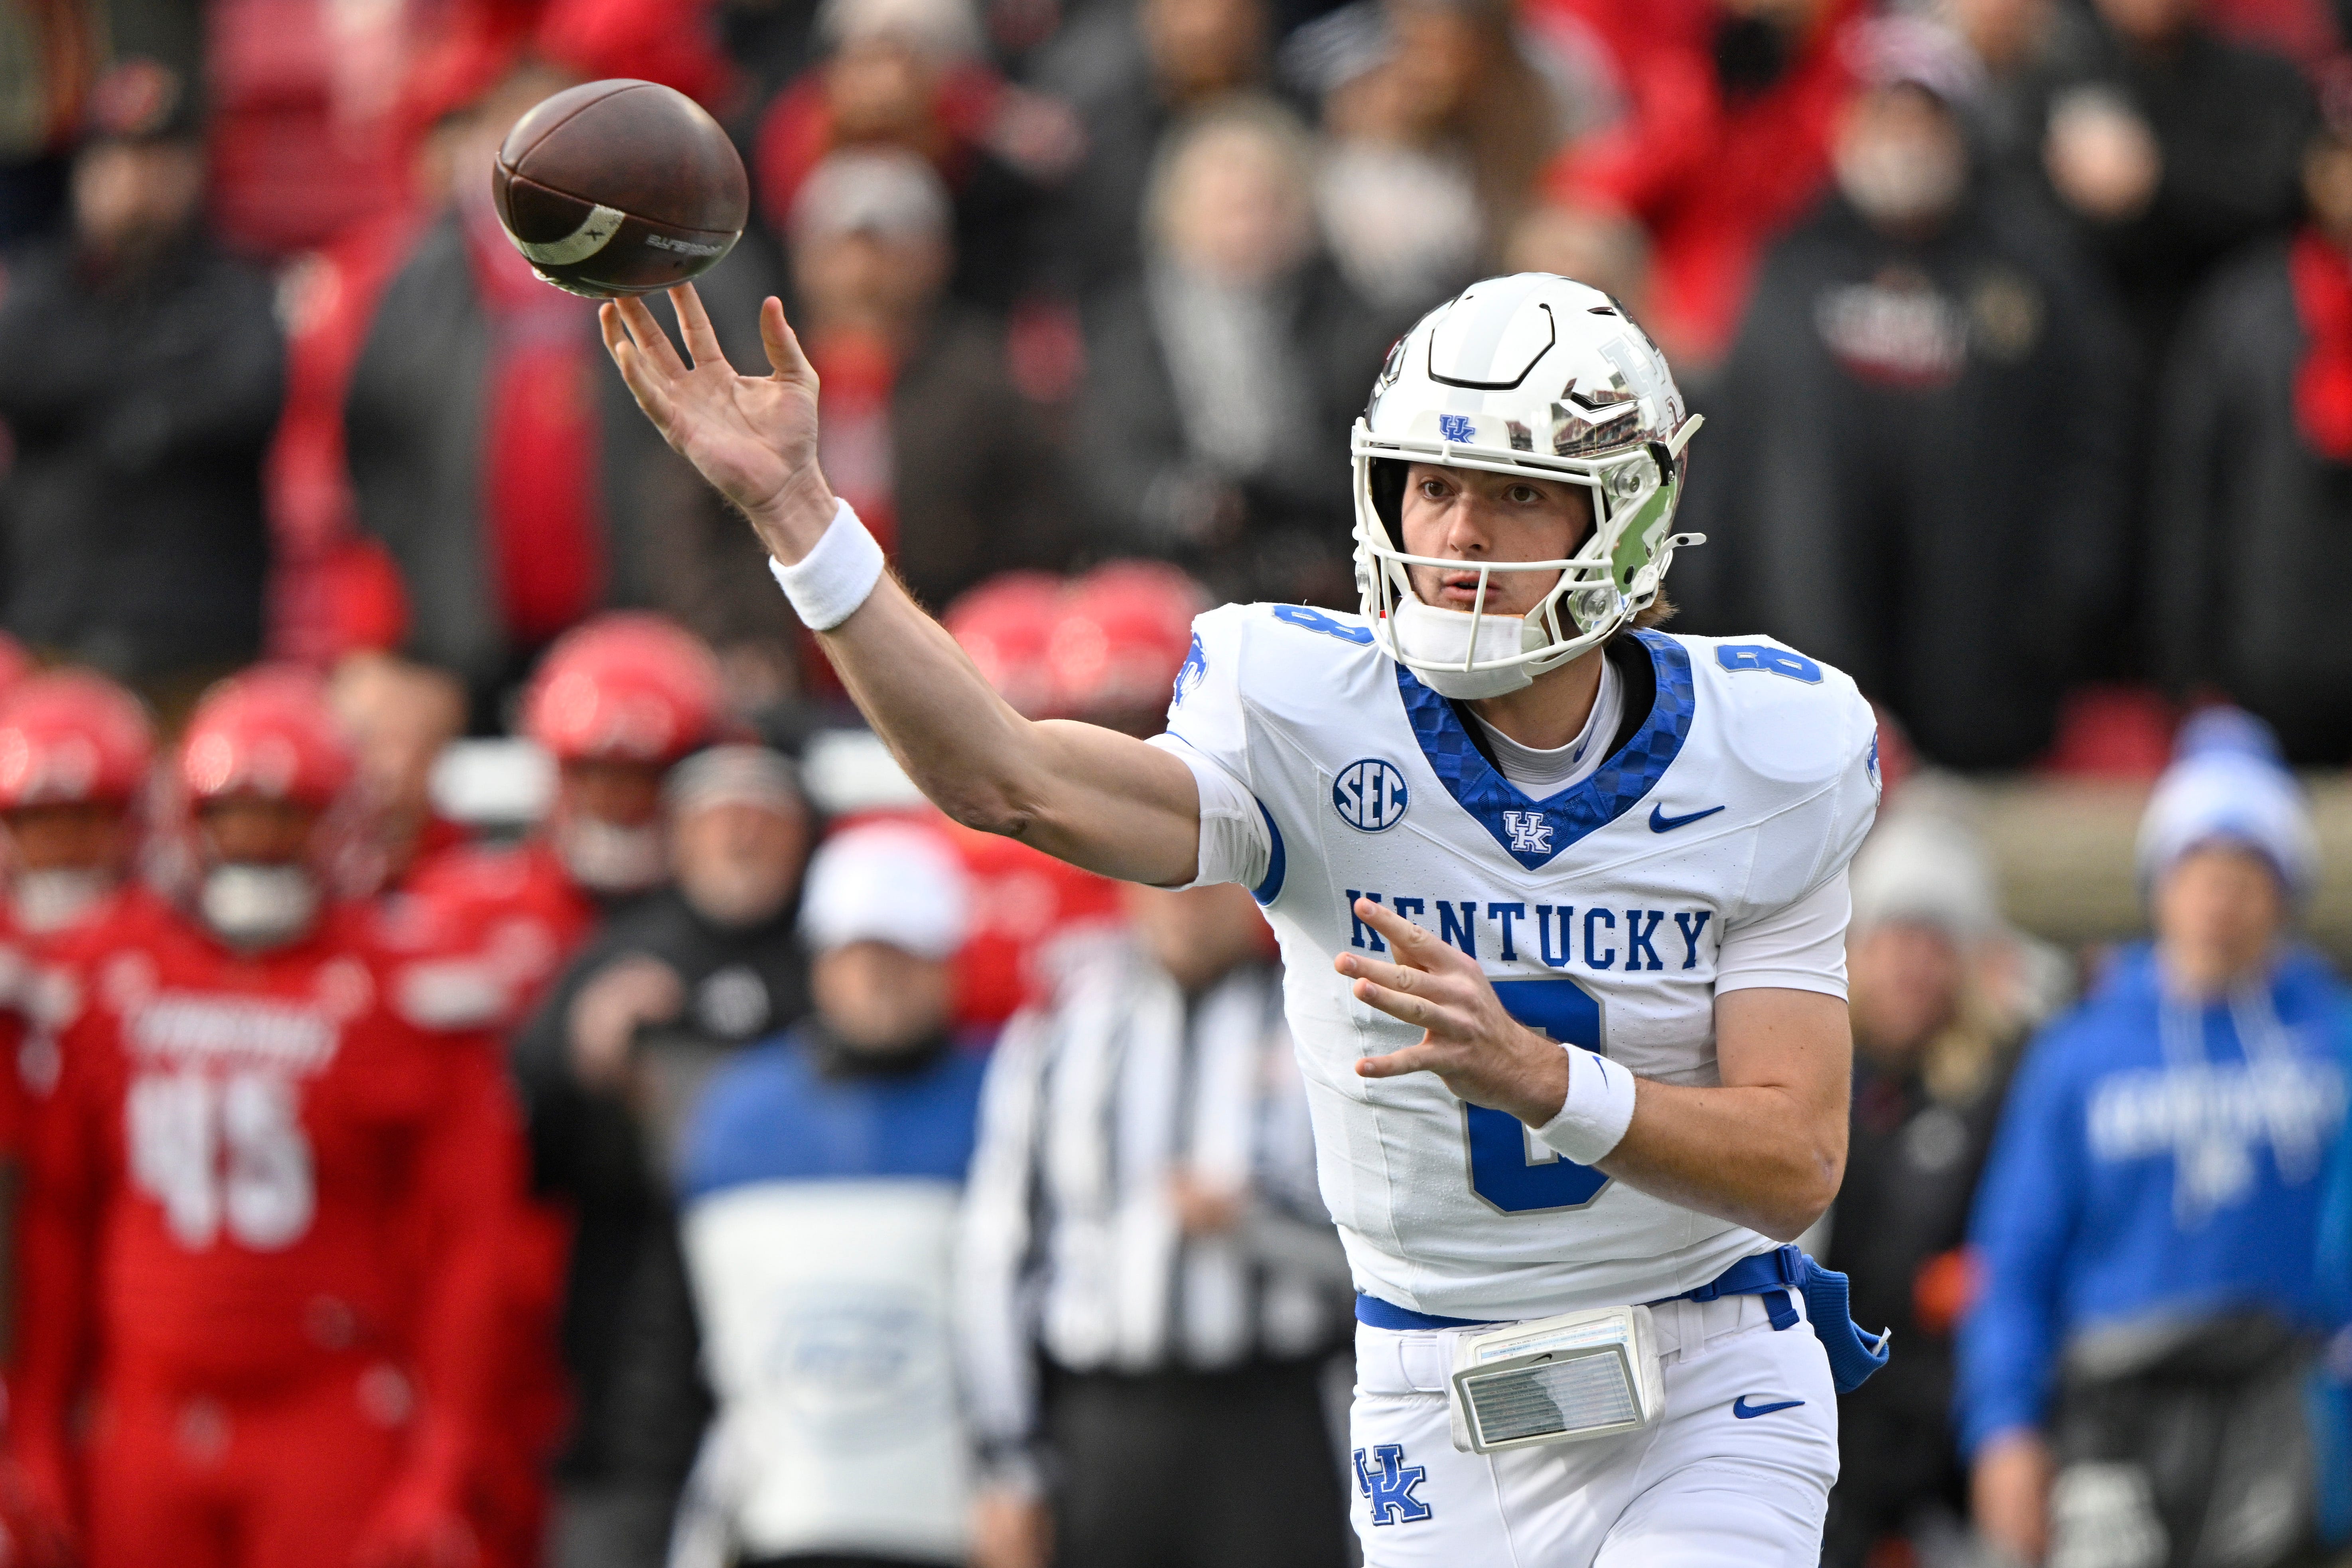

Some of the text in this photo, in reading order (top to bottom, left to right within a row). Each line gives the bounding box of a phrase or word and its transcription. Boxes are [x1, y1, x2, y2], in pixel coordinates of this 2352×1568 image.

[1439, 414, 1476, 444] UK
[1272, 605, 1376, 647] 8
[1713, 644, 1824, 686] 8
[1337, 762, 1404, 829] SEC
[1503, 810, 1554, 854] UK
[1352, 1443, 1432, 1527] UK
